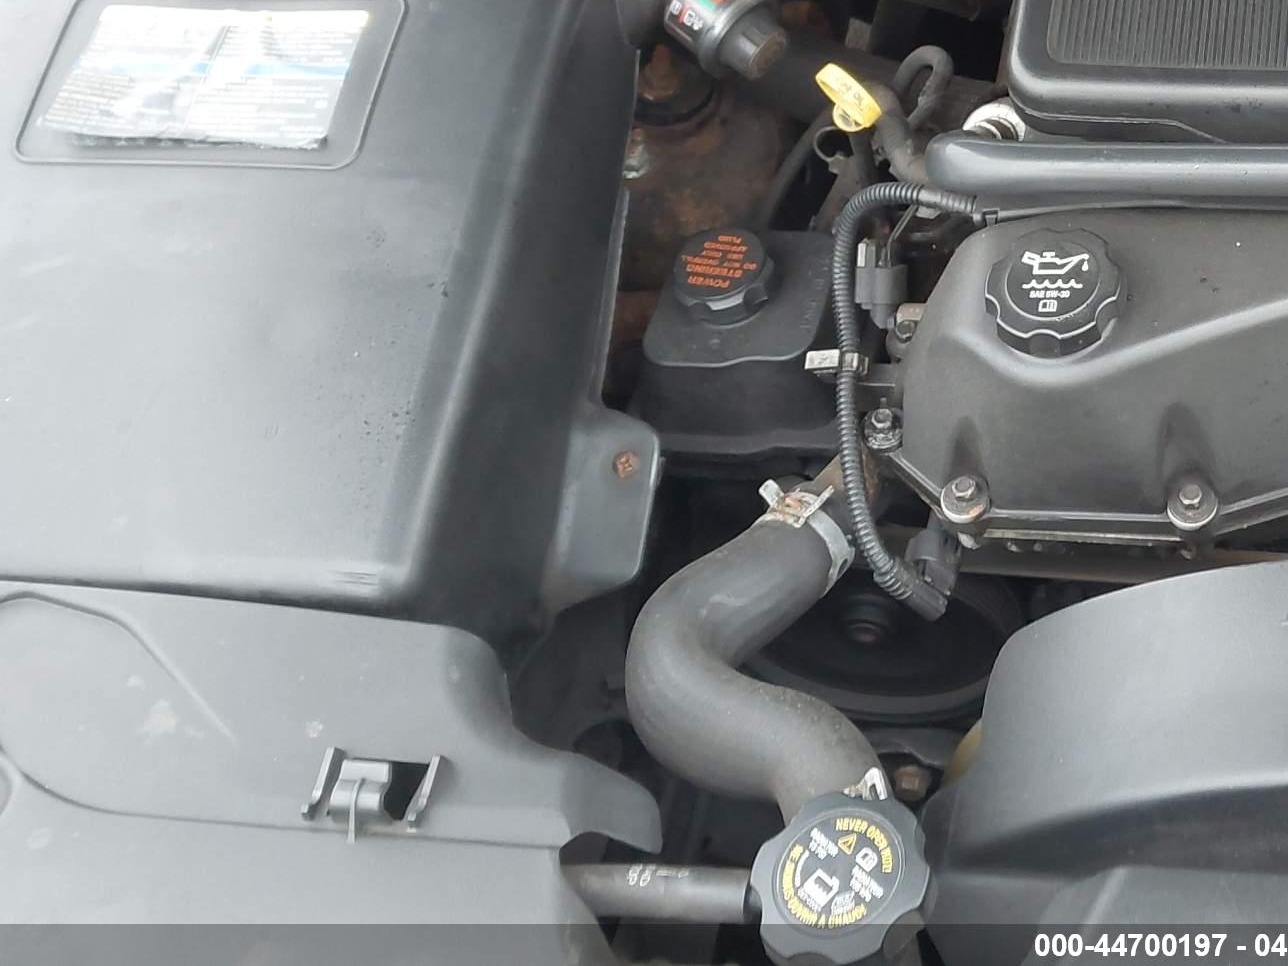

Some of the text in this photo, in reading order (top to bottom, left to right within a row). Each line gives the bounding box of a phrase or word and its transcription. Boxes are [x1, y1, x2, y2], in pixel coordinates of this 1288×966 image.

[686, 264, 743, 278] STEERING
[688, 275, 730, 288] POWER
[1029, 290, 1070, 298] SAE 5W-30
[836, 818, 868, 834] NEVER
[867, 825, 888, 852] OPEN
